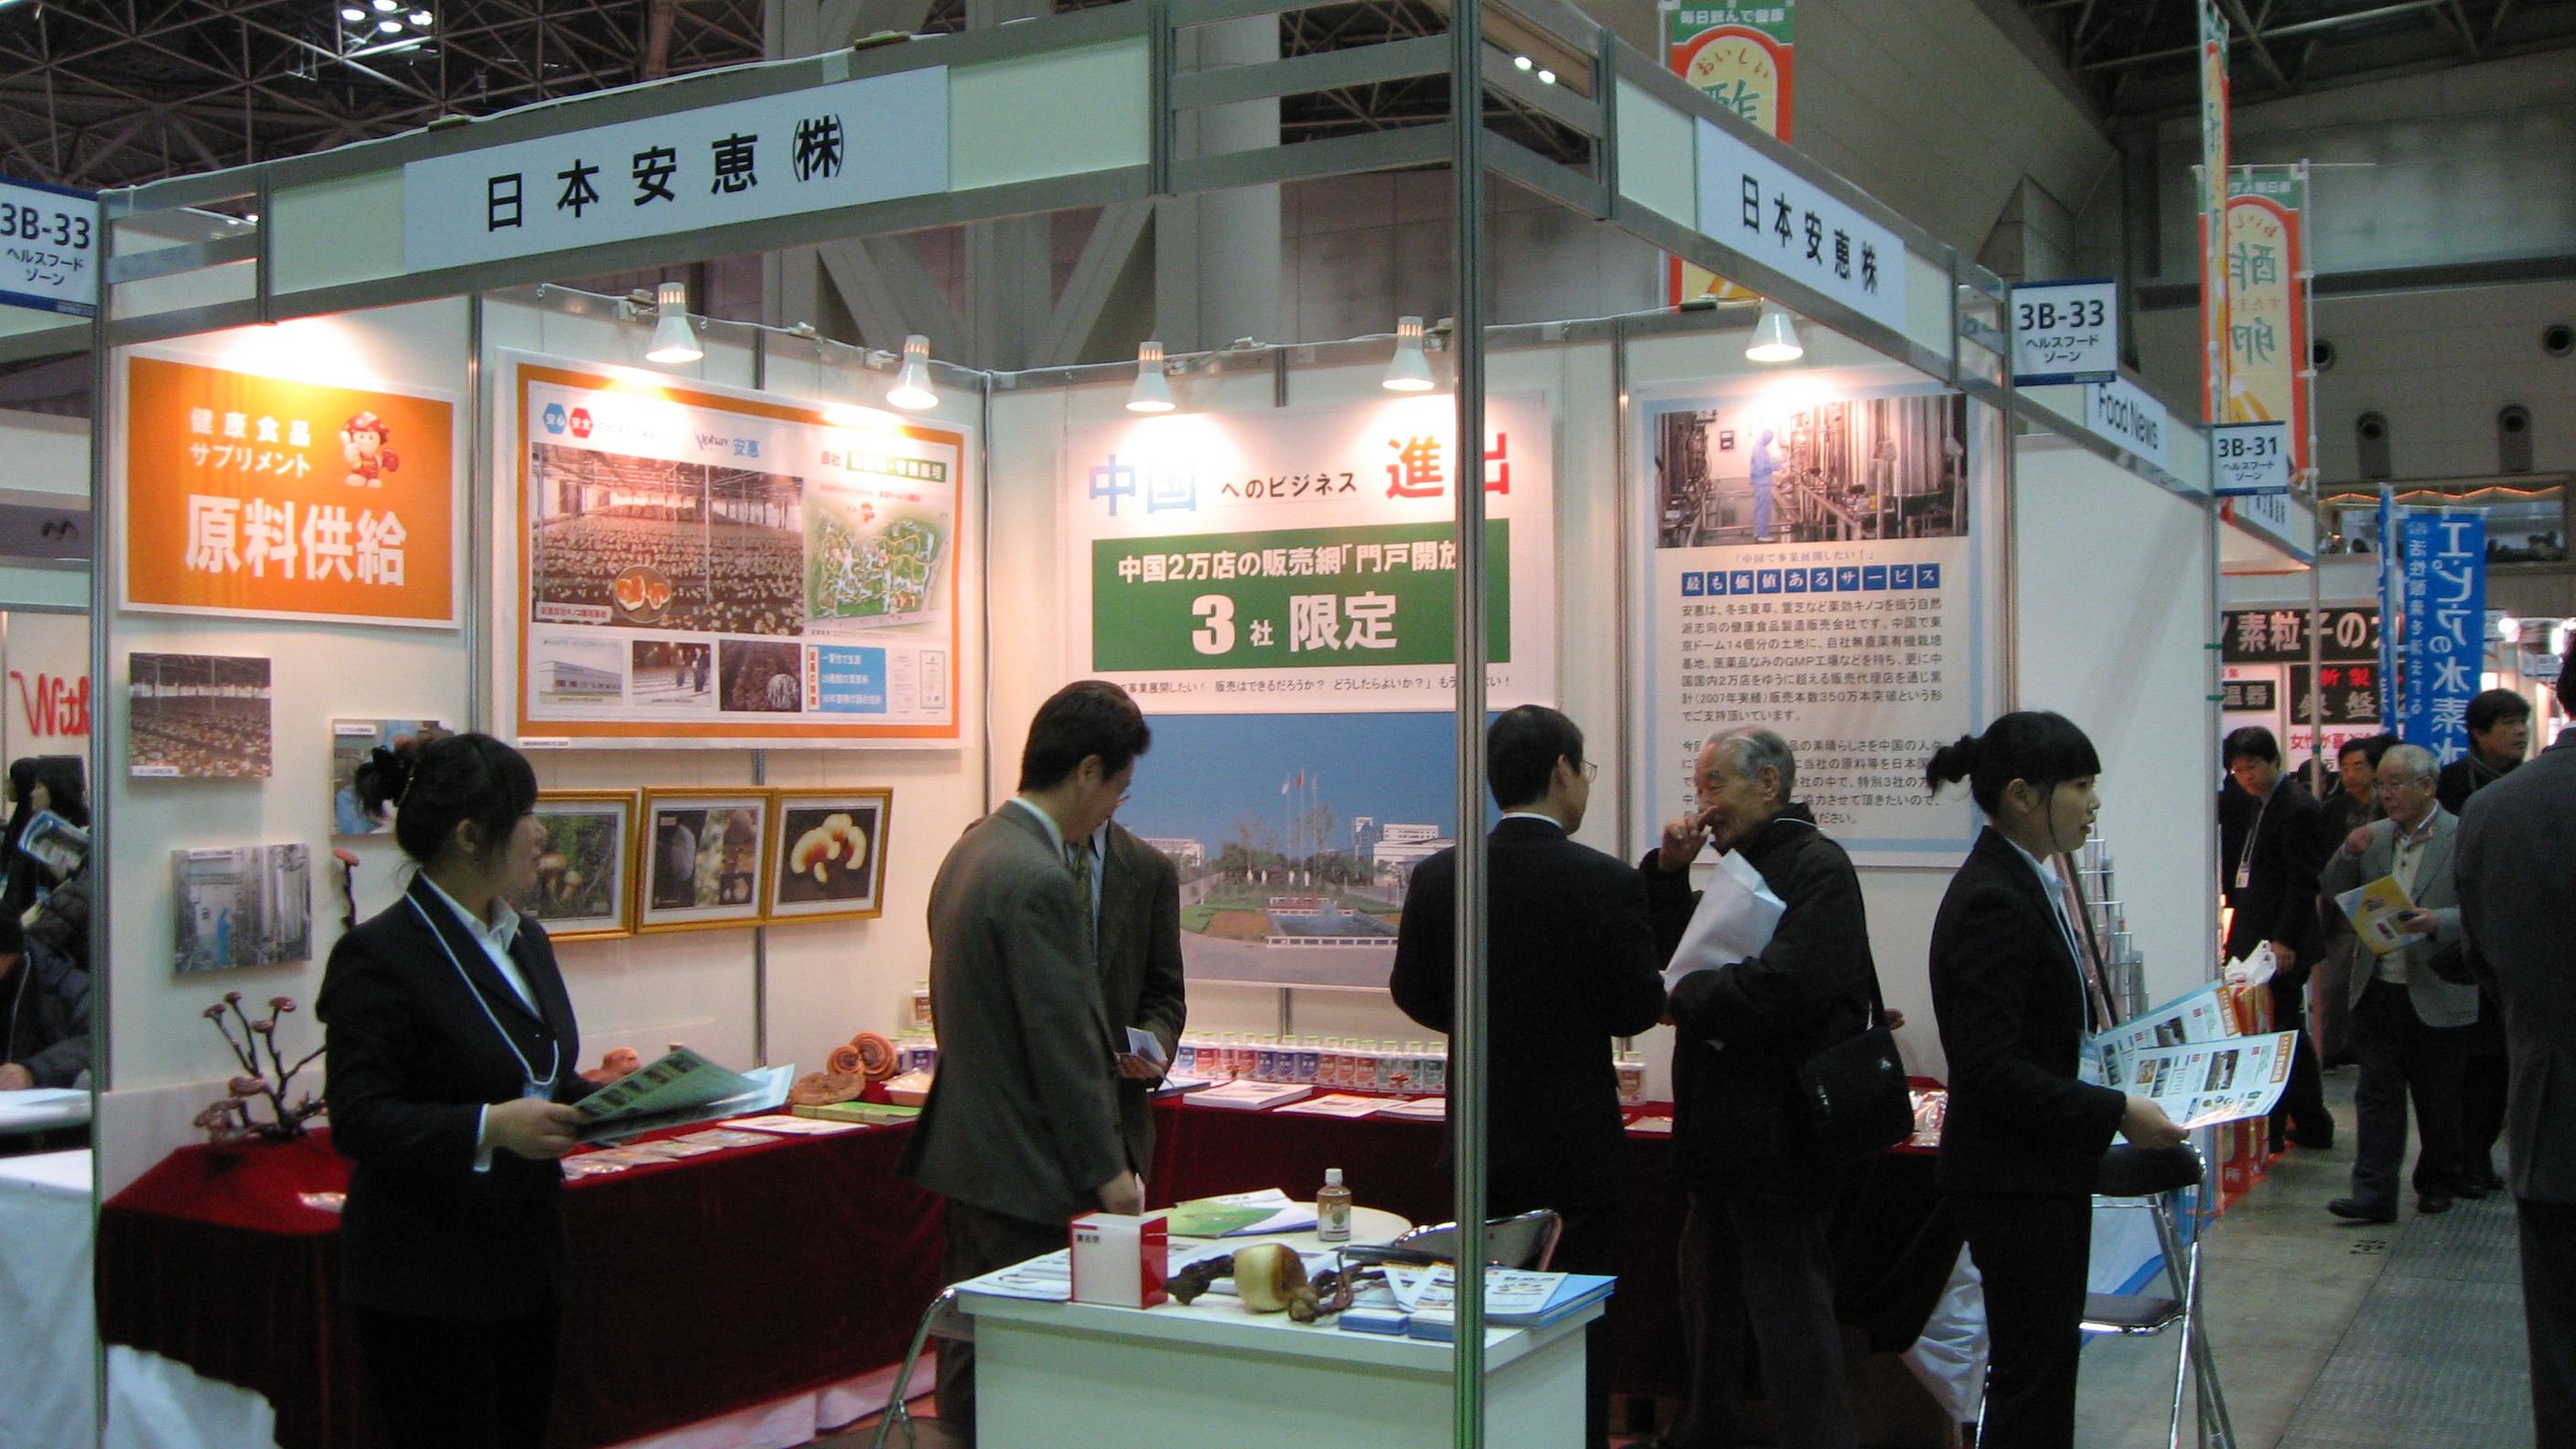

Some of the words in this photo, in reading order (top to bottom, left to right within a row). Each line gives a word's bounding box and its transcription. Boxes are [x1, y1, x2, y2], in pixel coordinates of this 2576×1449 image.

[1697, 48, 1769, 78] おいしい
[0, 203, 90, 250] 3B-33
[7, 248, 85, 272] ヘルスフード
[27, 268, 65, 285] ゾーン
[2019, 299, 2105, 331] 3B-33
[2025, 334, 2099, 349] ヘルスフード
[2044, 350, 2081, 363] ゾーン
[189, 407, 312, 446] 健康食品
[189, 442, 311, 478] サプリメント
[2217, 436, 2279, 457] 3B-31
[2223, 461, 2275, 472] ヘルスフード
[2235, 471, 2263, 481] ゾーン
[1089, 452, 1197, 517] 中国
[1221, 472, 1358, 499] へのビジネス
[185, 493, 408, 586] 原料供給
[1685, 567, 1937, 592] 最も価値あるサービス
[2223, 610, 2381, 652] 素粒子の
